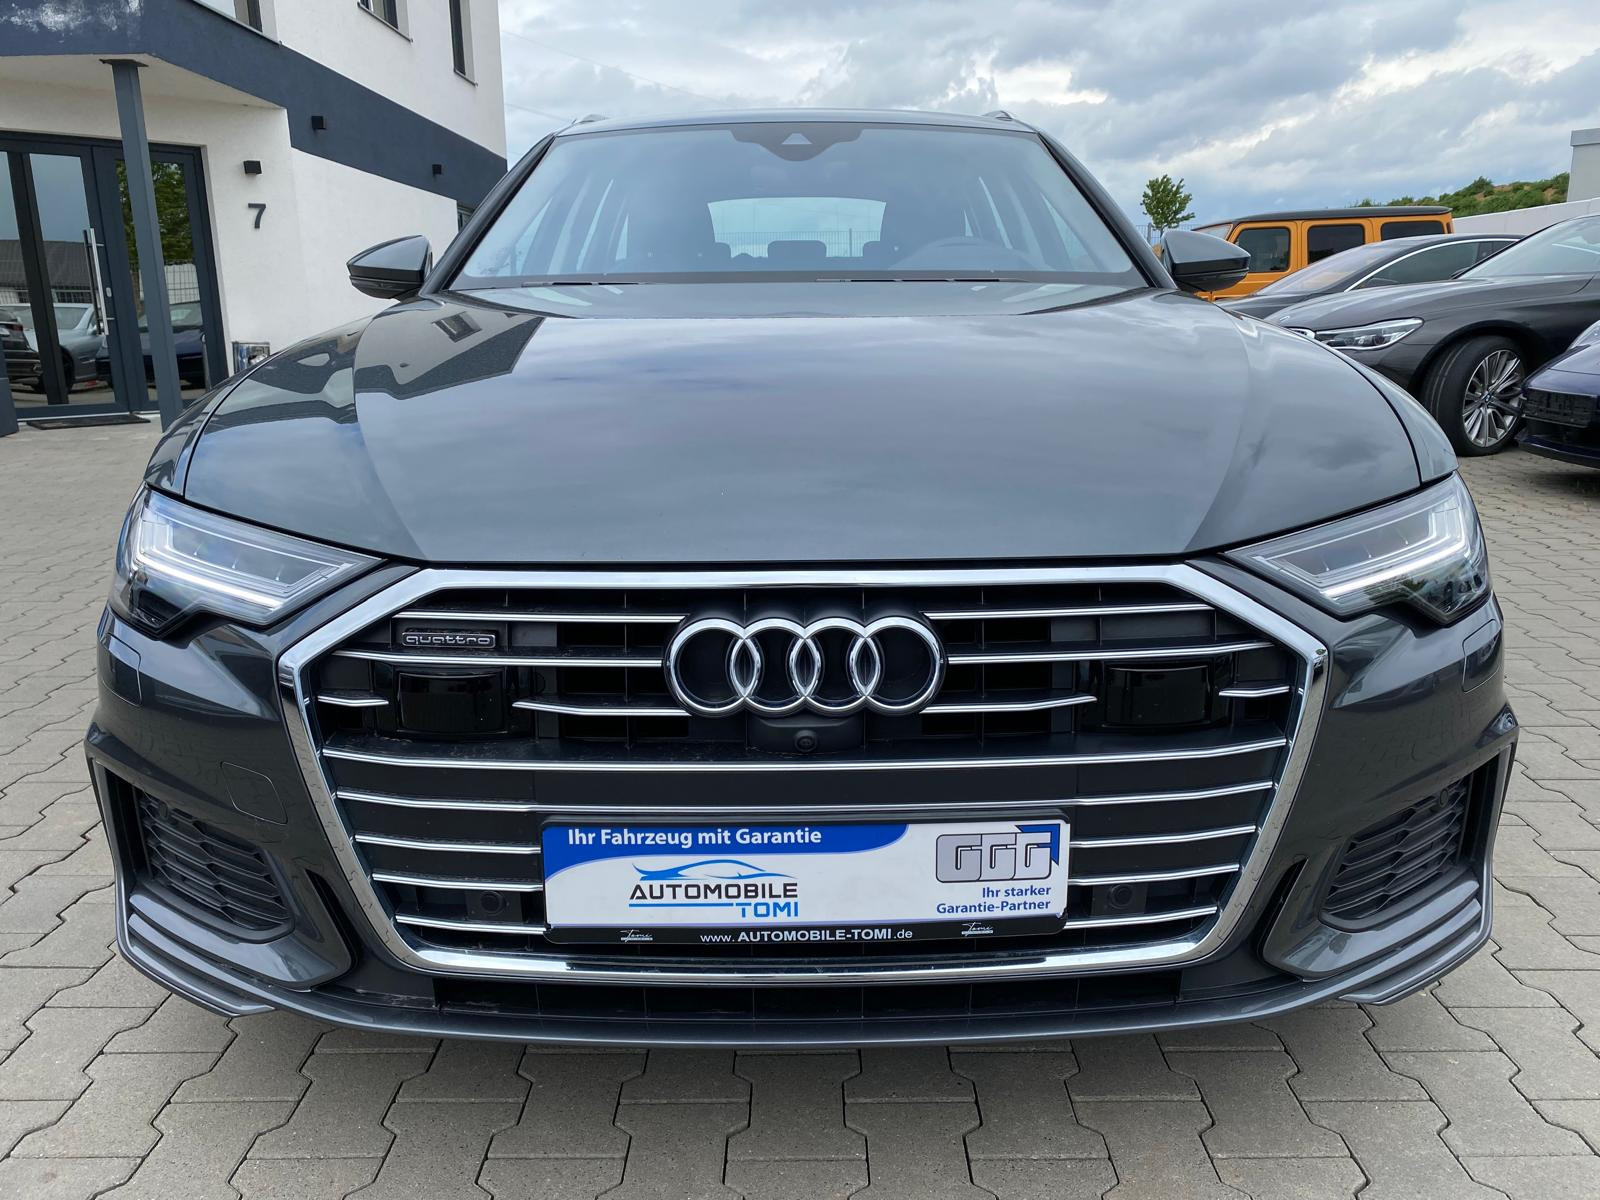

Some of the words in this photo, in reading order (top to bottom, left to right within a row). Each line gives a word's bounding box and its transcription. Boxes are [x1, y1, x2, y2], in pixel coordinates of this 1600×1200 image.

[247, 203, 267, 229] 7
[406, 635, 491, 645] quattro
[568, 829, 596, 845] Ihr
[601, 828, 693, 848] Fahrzeug
[698, 828, 731, 845] mit
[735, 827, 822, 844] Garantie
[629, 882, 798, 900] AUTOMOBILE
[982, 886, 1000, 898] Ihr
[1004, 885, 1051, 898] starker
[735, 902, 798, 918] TOMI
[936, 900, 1051, 914] Garantie-Partner
